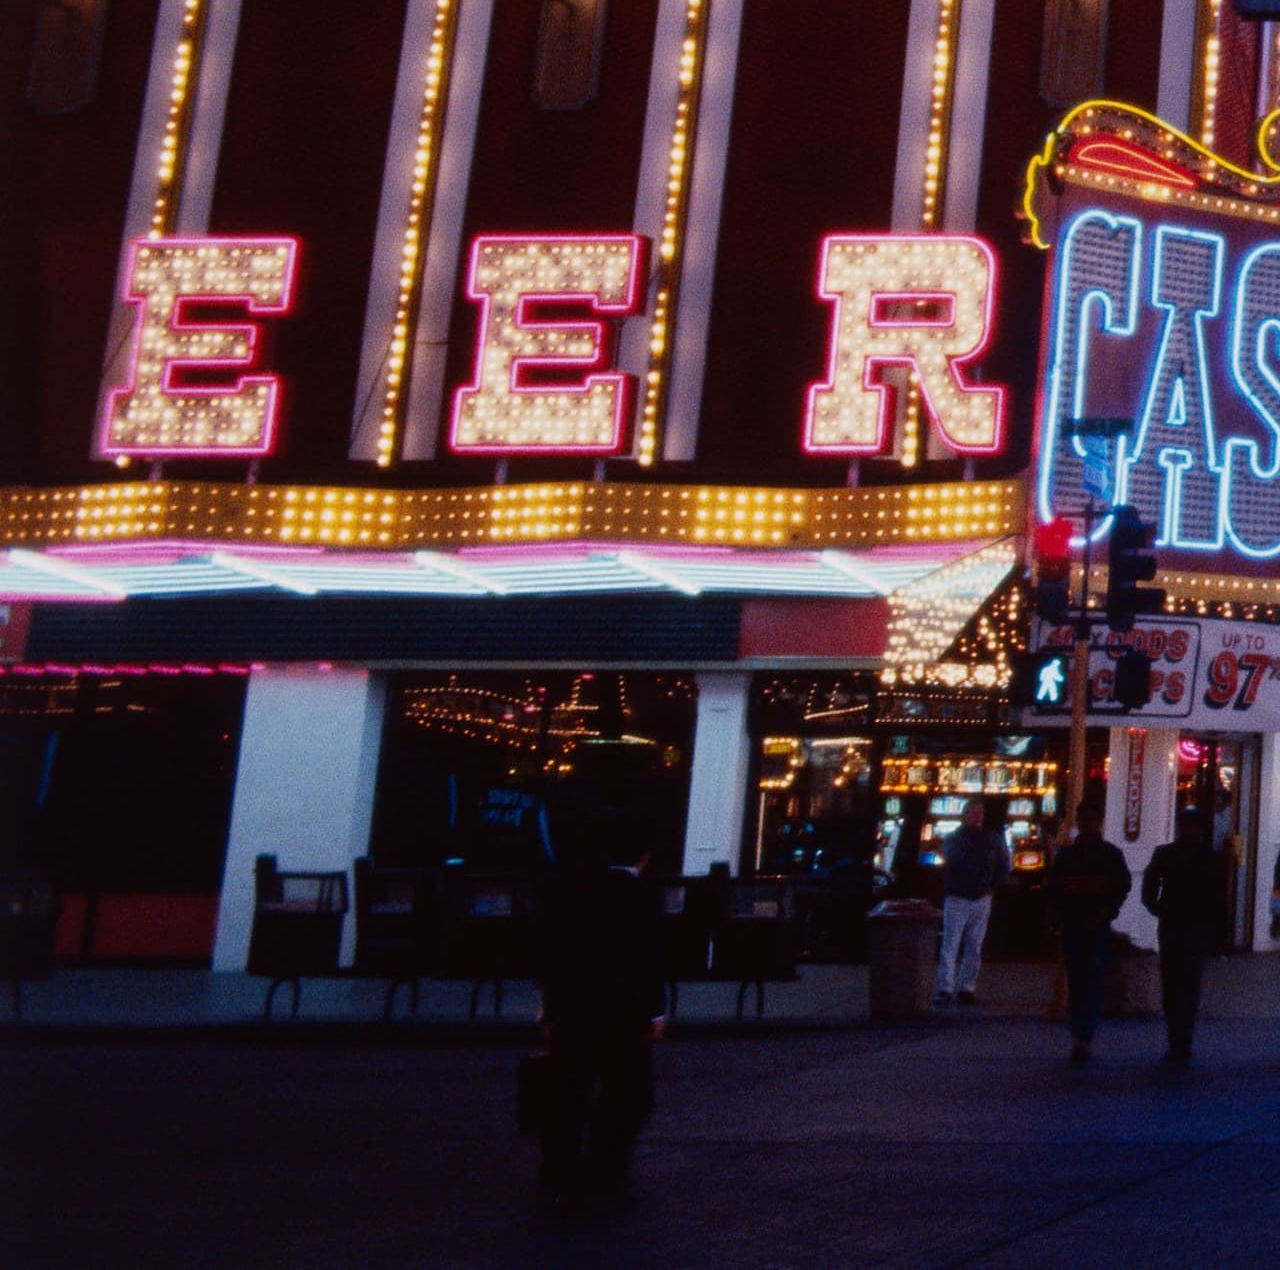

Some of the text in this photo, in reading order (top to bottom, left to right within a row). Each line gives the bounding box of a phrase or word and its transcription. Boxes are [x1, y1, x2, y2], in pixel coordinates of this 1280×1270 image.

[102, 234, 1004, 456] EER
[1222, 633, 1265, 650] UP TO
[1092, 668, 1187, 702] CPS
